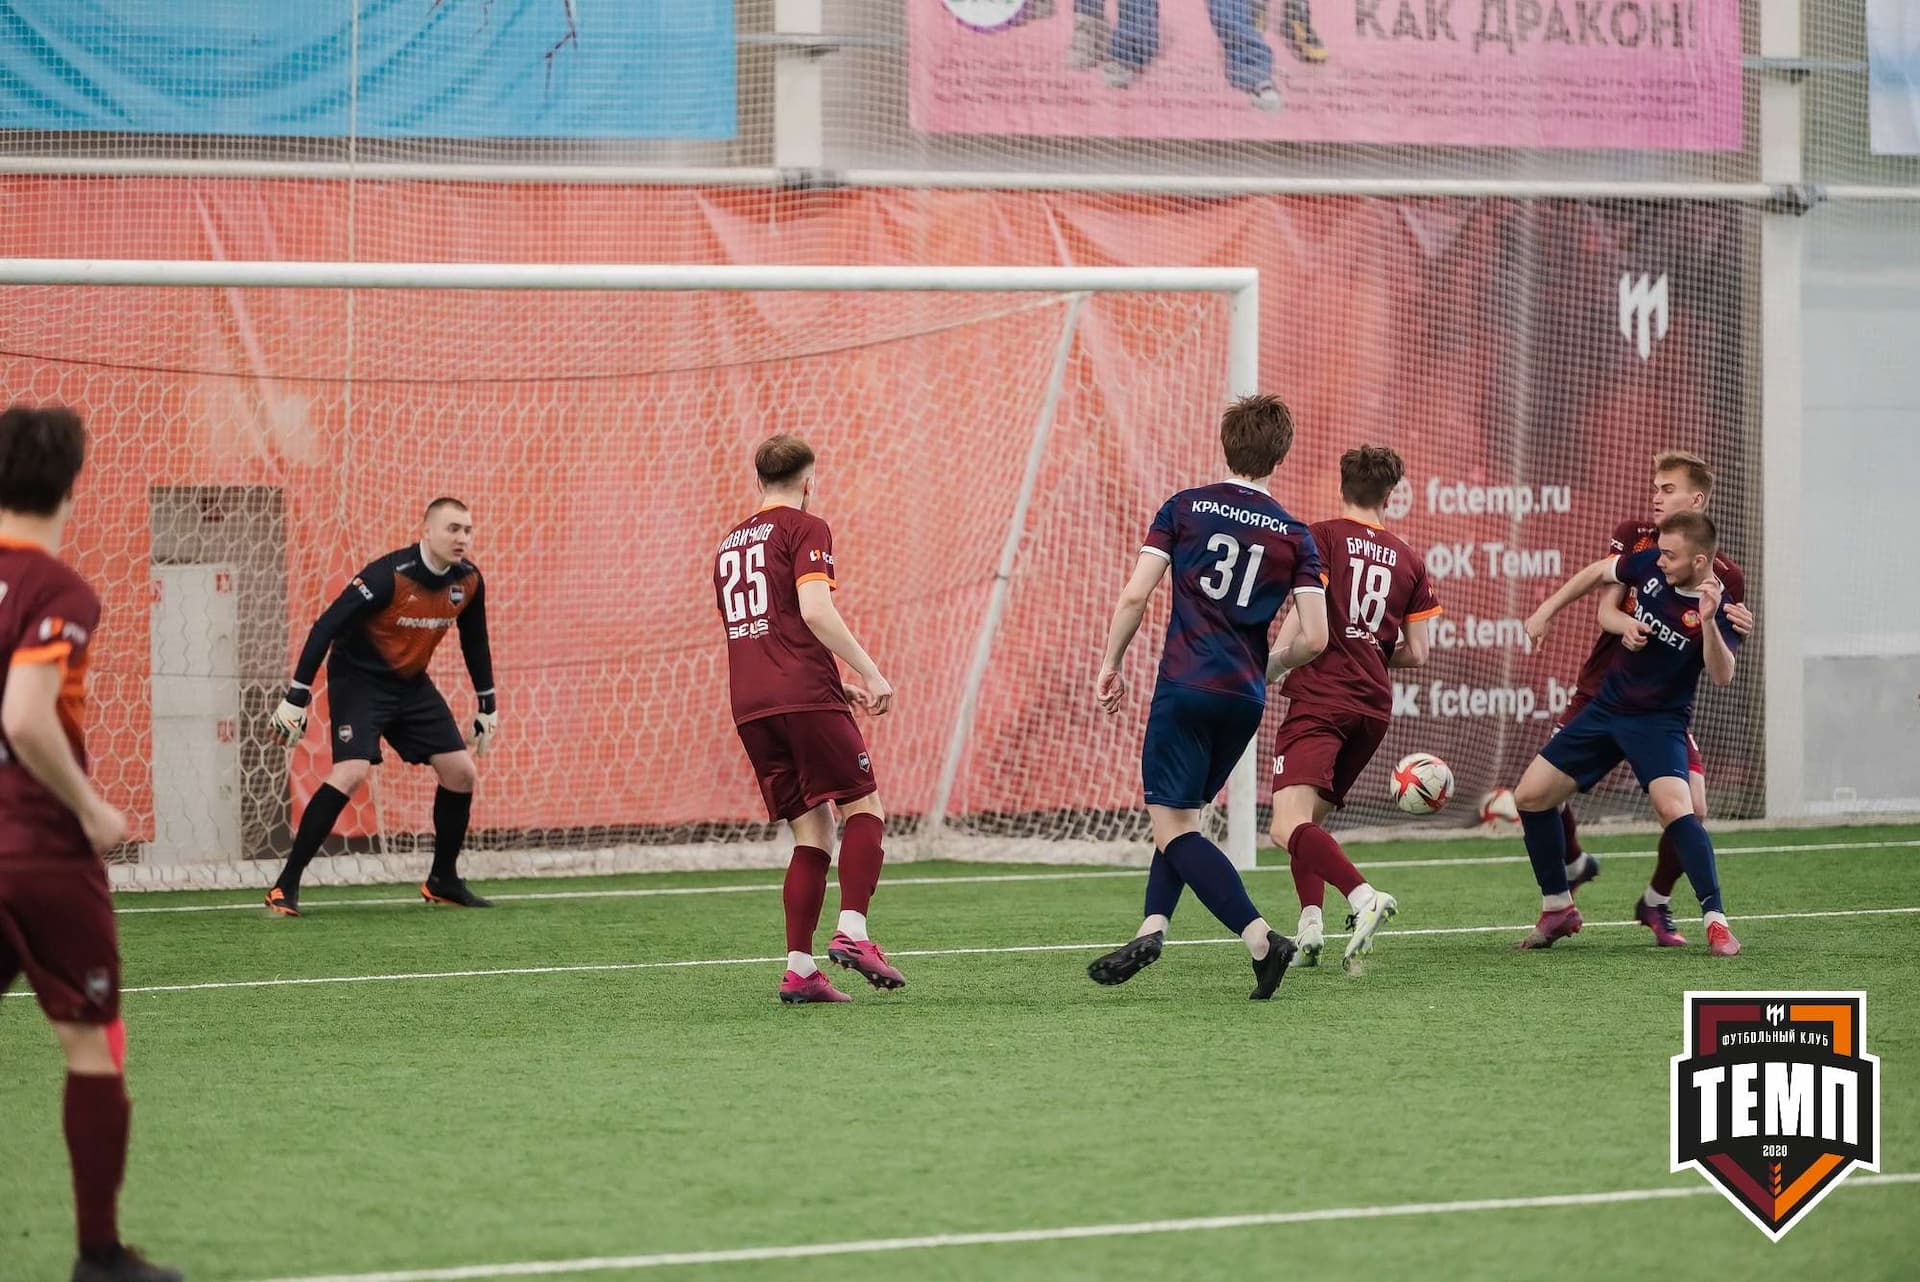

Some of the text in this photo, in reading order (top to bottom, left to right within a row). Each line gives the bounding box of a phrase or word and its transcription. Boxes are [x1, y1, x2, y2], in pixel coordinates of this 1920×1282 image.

[1354, 0, 1697, 53] КАК ДРАКОН!
[1192, 500, 1288, 535] КРАСНОЯРСК
[1426, 477, 1571, 520] fctemp.ru
[1199, 533, 1265, 608] 31
[1346, 537, 1397, 567] БРИЧЕЕВ
[1426, 543, 1561, 578] ФК Темп
[719, 543, 769, 623] 25
[1349, 558, 1392, 632] 18
[1634, 600, 1691, 651] АССВЕТ
